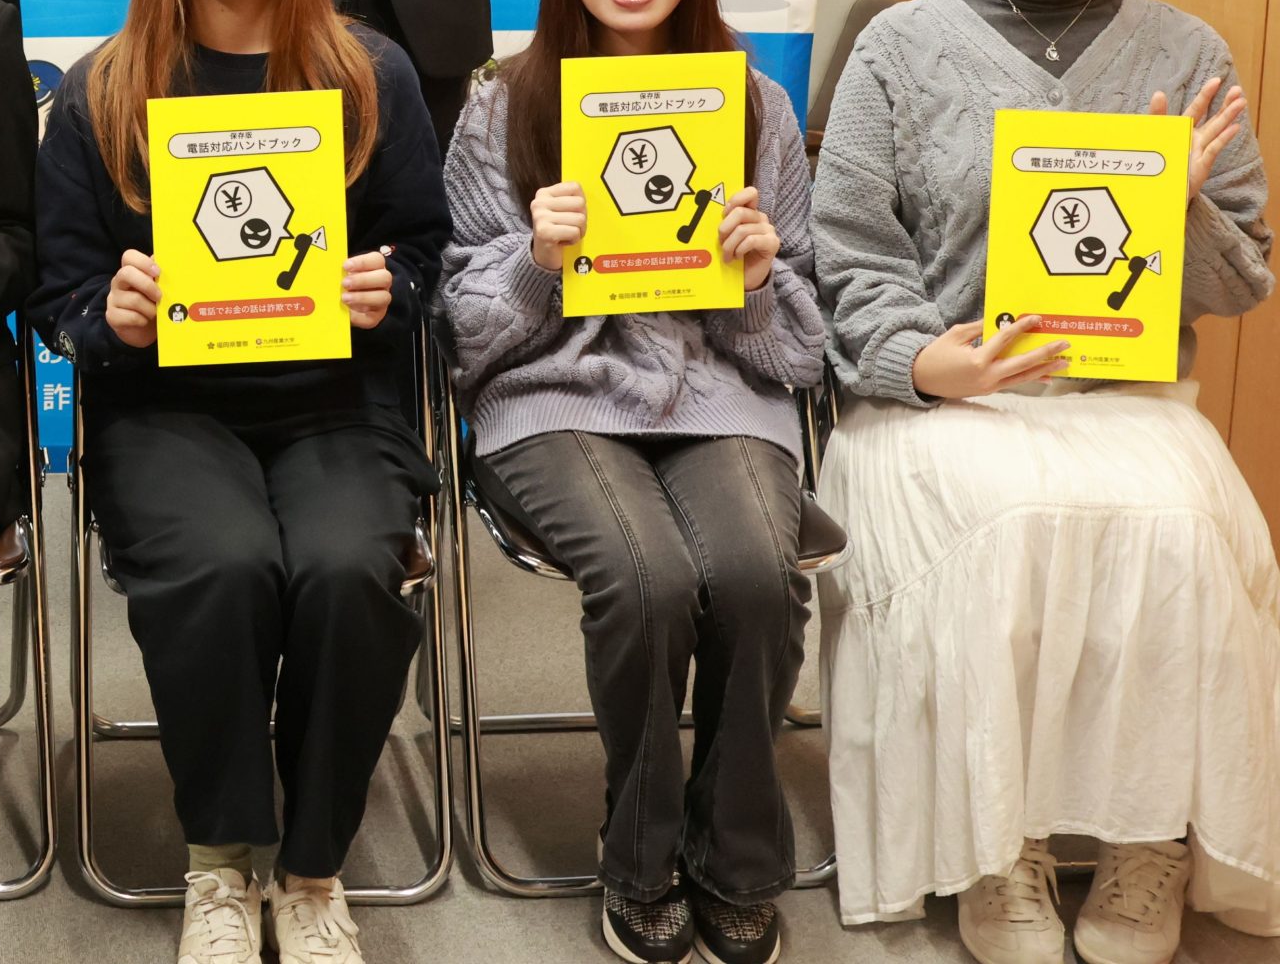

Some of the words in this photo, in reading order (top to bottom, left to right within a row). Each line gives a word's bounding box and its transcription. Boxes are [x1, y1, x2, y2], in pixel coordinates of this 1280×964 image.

[599, 98, 706, 113] 電話対応ハンドブック
[187, 138, 301, 154] 電話対応ハンドブック
[1031, 157, 1145, 171] 電話対応ハンドブック
[603, 256, 702, 268] 電話でお金の話は詐欺です。
[198, 303, 305, 316] 電話でお金の話は詐欺です。
[1037, 320, 1133, 333] でお金の話は詐欺です。
